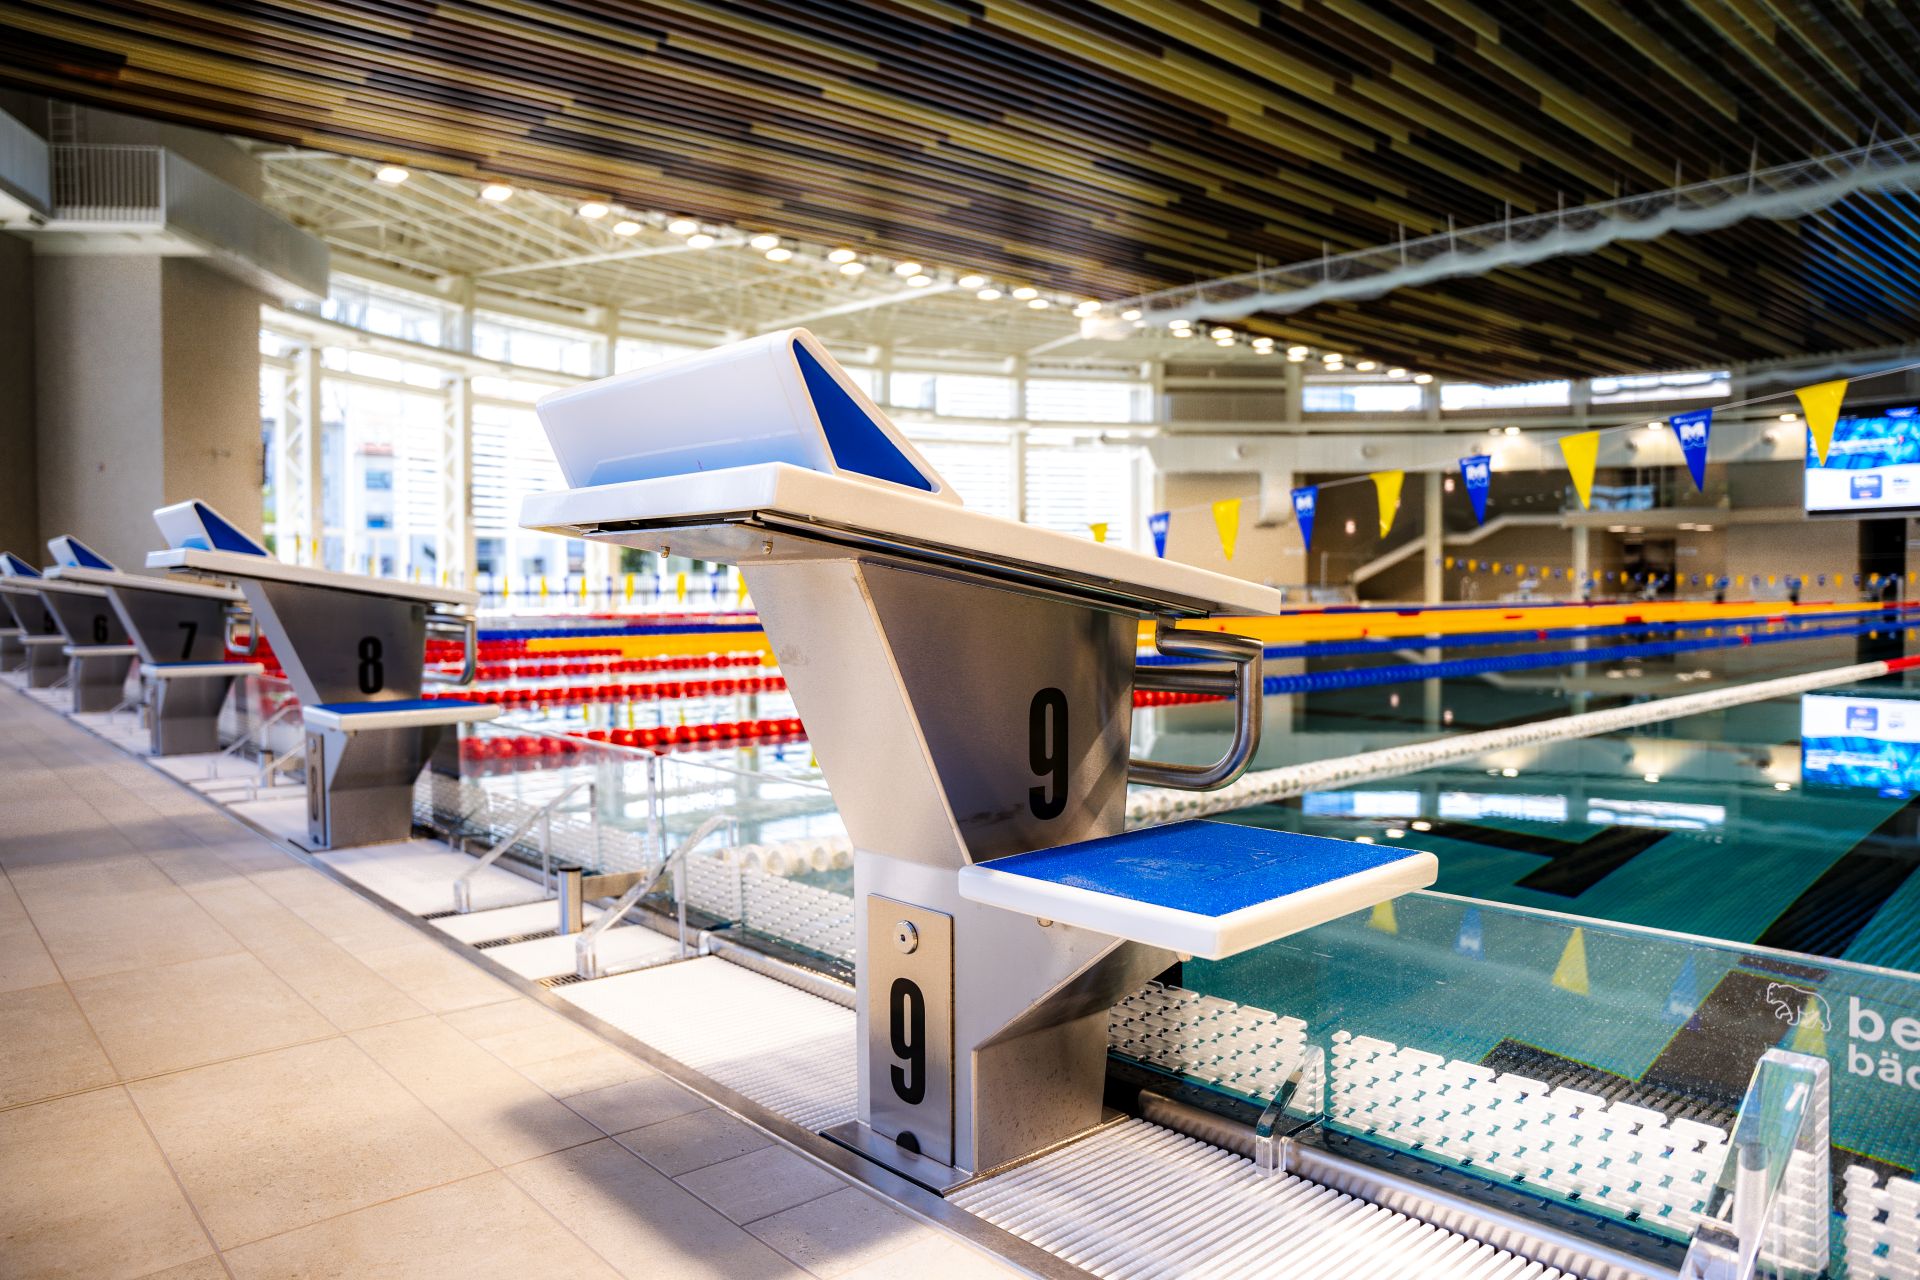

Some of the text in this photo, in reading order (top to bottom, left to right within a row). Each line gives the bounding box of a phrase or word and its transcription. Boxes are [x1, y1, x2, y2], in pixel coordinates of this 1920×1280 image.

[93, 614, 108, 643] 6
[178, 621, 198, 660] 7
[358, 636, 384, 694] 8
[1029, 687, 1069, 820] 9
[890, 977, 926, 1105] 9
